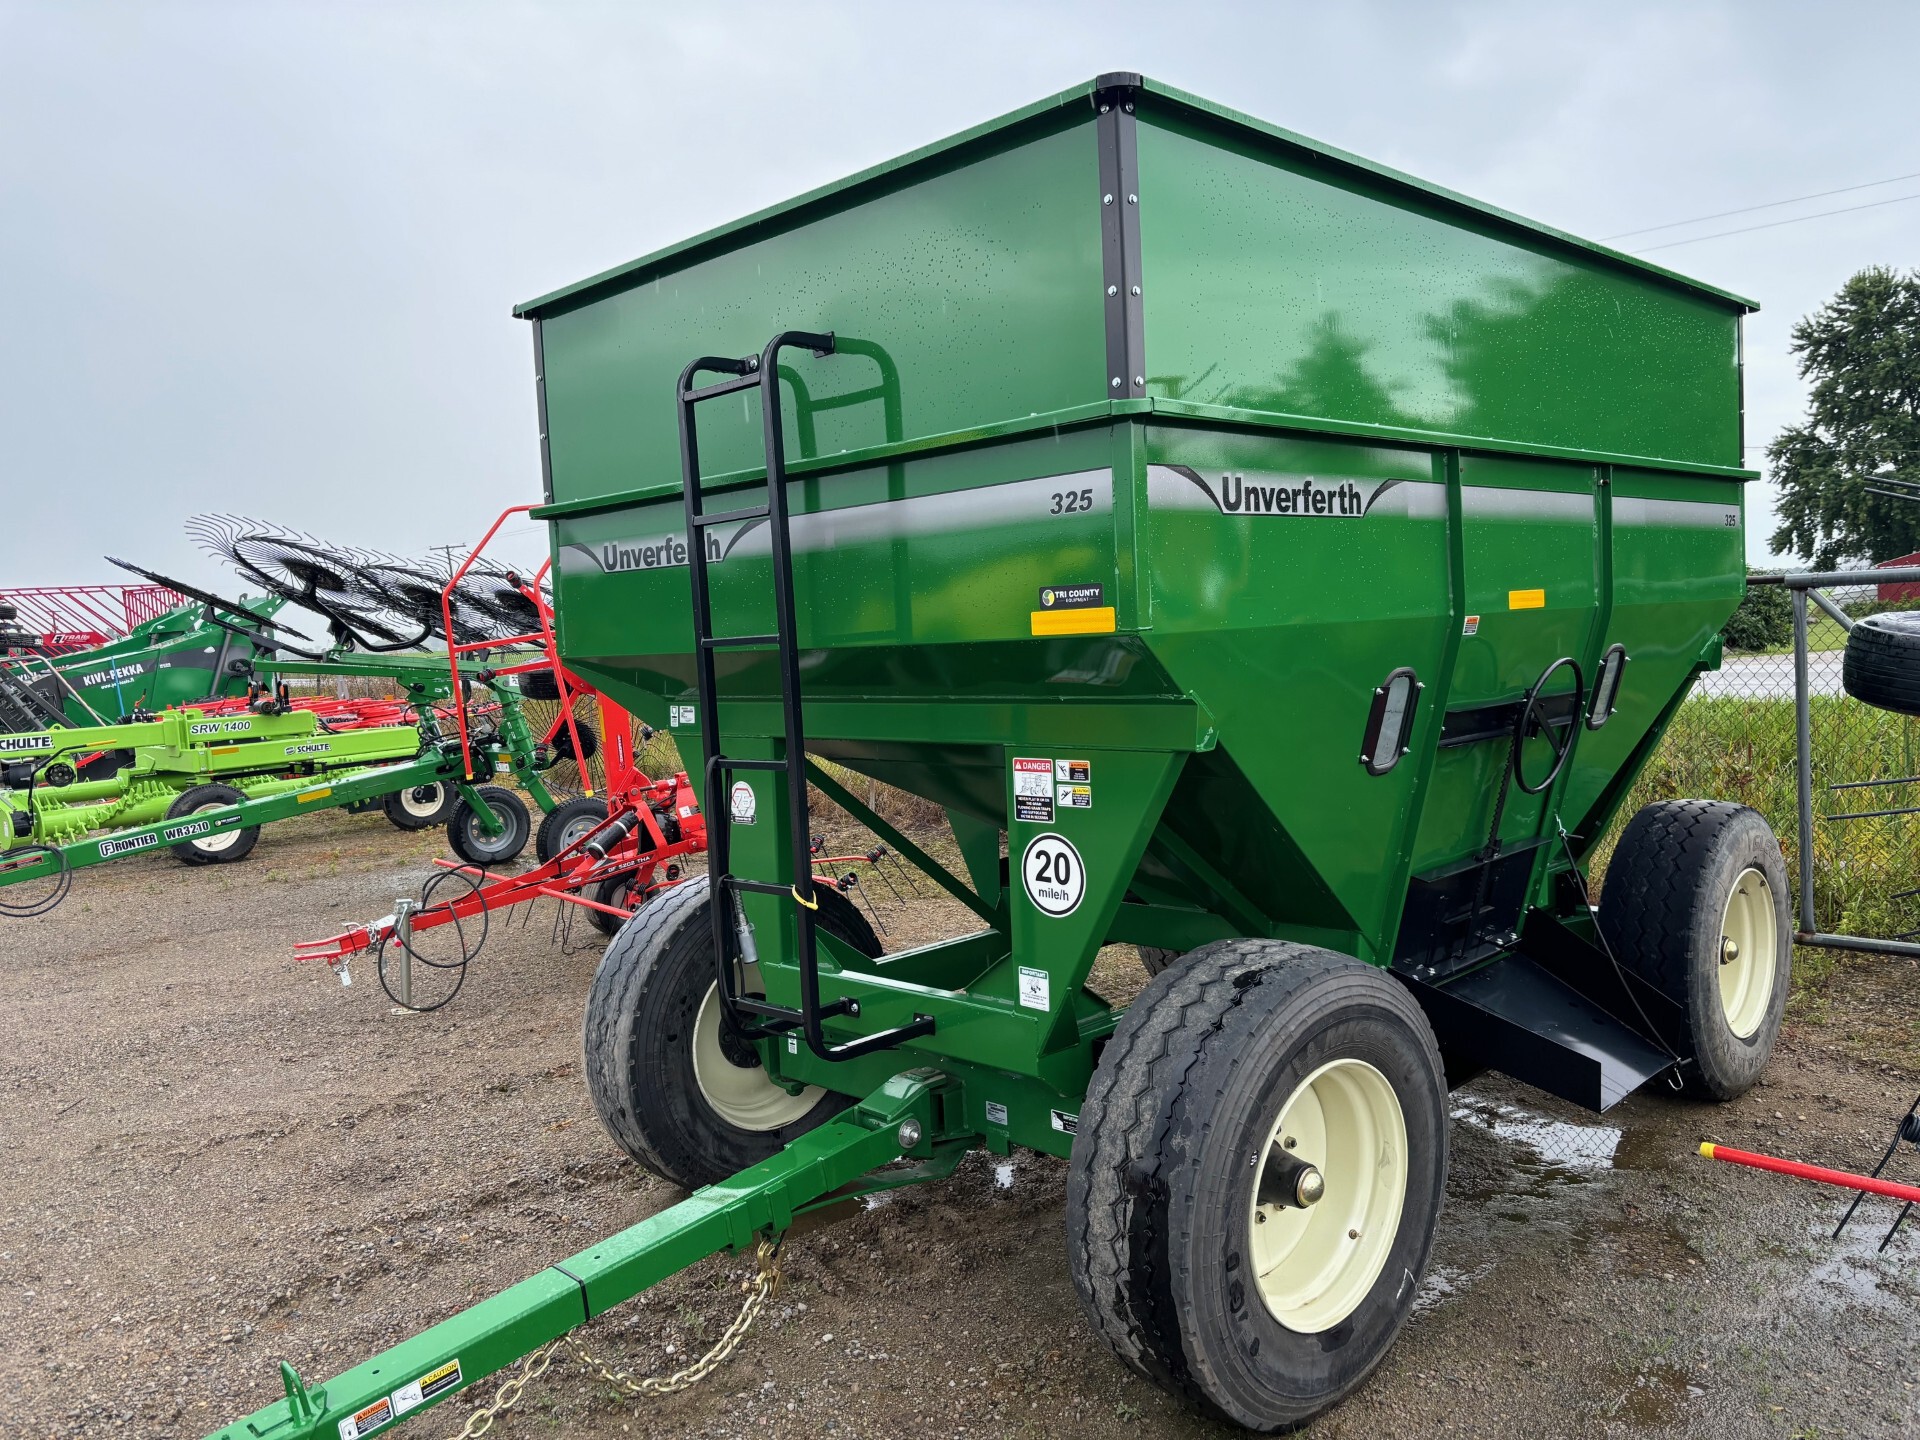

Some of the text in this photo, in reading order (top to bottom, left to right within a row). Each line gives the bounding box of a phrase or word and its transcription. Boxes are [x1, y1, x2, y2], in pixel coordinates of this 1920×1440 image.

[1050, 488, 1093, 515] 325
[1221, 476, 1362, 516] Unverferth
[1724, 514, 1736, 527] 325
[603, 532, 721, 571] Unverfeh
[1055, 588, 1100, 599] TRI COUNTY
[191, 721, 251, 734] SRW 1400
[297, 743, 330, 753] SCHULTE
[1022, 761, 1051, 771] DANGER
[100, 821, 209, 857] FRONTIER WR3210
[1034, 849, 1071, 886] 20
[1038, 887, 1070, 902] mile/h
[427, 1362, 458, 1382] CAUTION
[361, 1400, 387, 1418] WARNING
